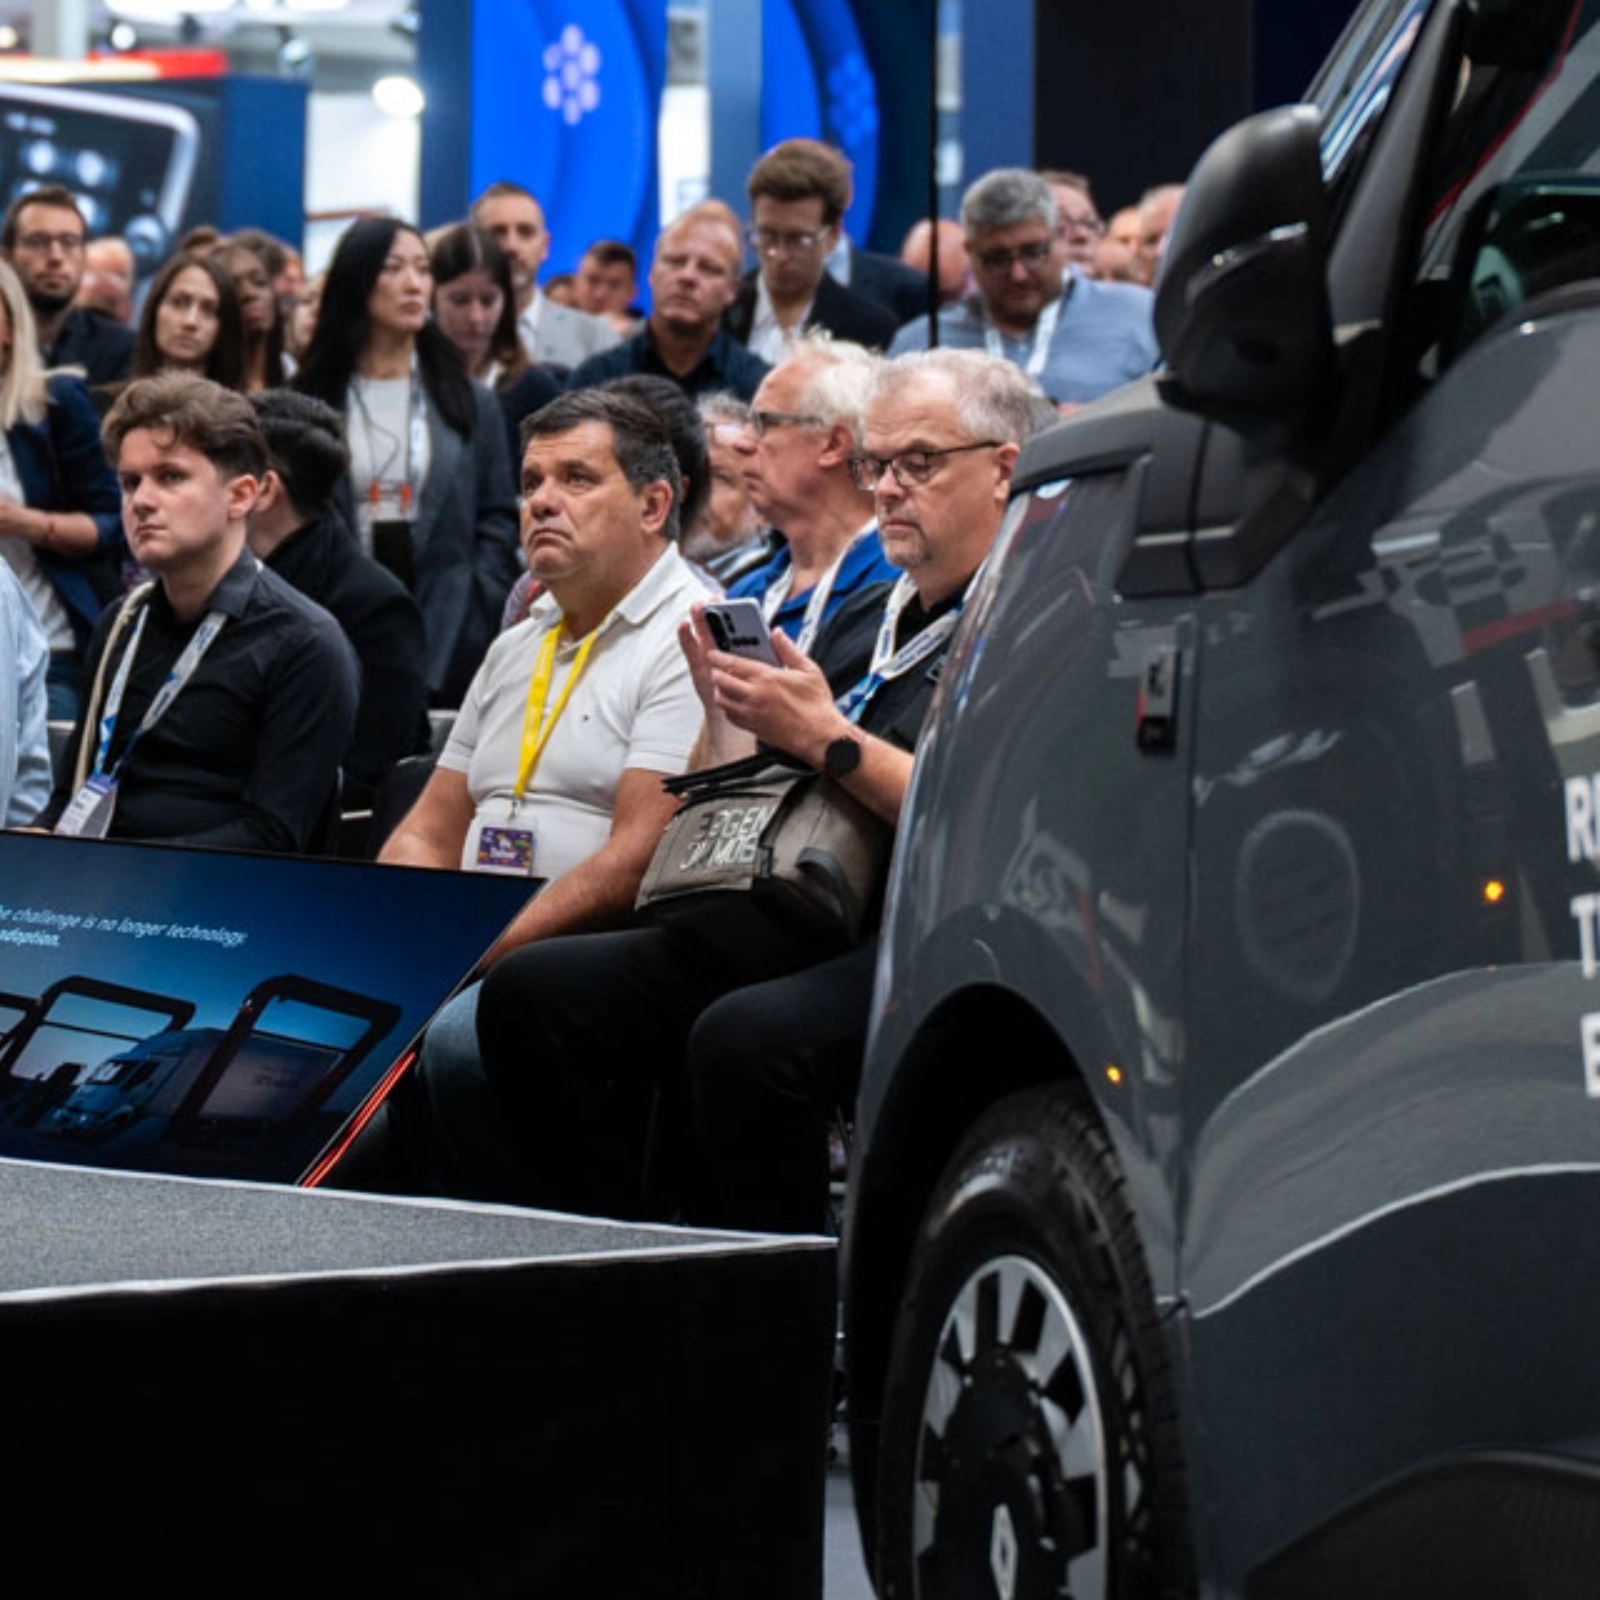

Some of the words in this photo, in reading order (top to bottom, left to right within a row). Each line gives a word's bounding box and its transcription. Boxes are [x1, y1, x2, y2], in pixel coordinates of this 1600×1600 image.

[12, 909, 81, 930] challenge
[81, 915, 96, 929] is
[97, 917, 118, 930] no
[117, 917, 167, 939] longer
